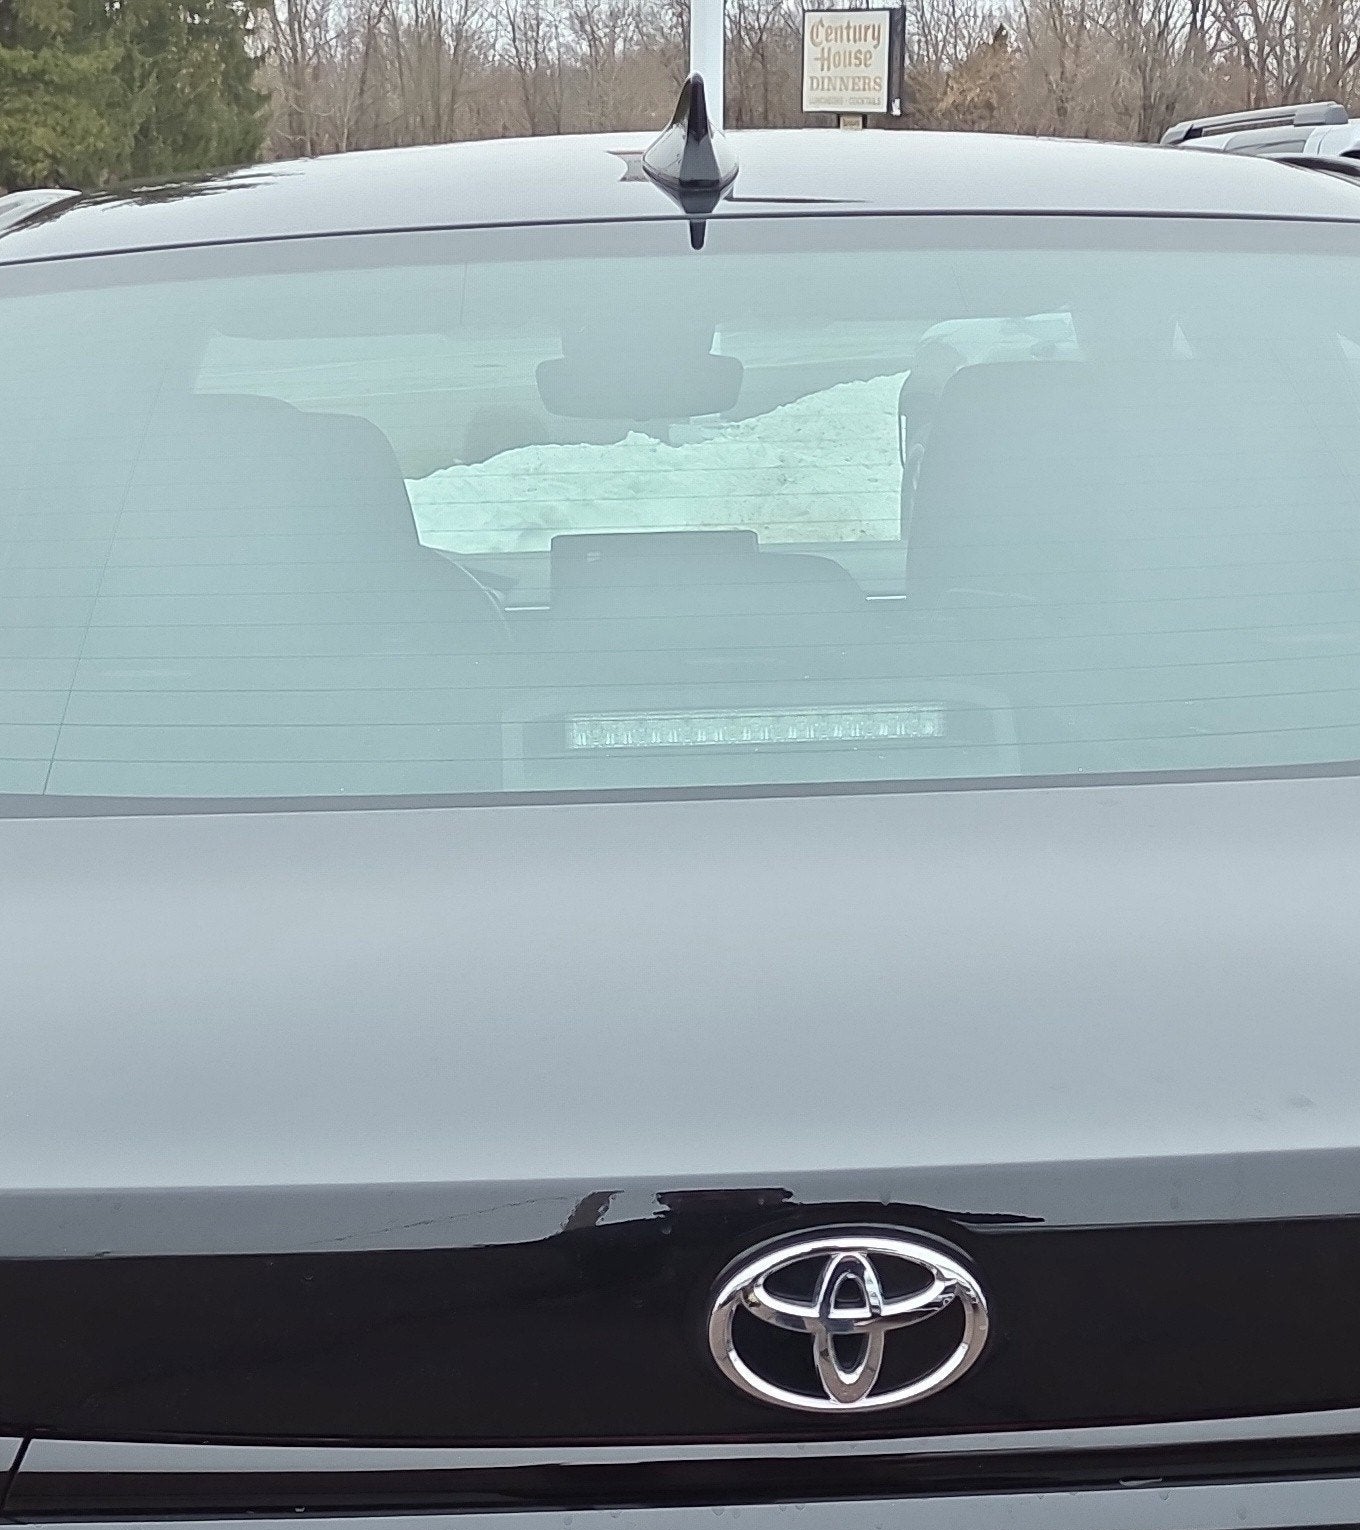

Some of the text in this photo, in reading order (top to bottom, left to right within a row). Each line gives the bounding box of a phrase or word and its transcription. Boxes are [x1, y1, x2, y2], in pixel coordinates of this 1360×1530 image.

[810, 17, 881, 49] Century
[814, 47, 873, 71] House
[809, 75, 882, 92] DINNERS
